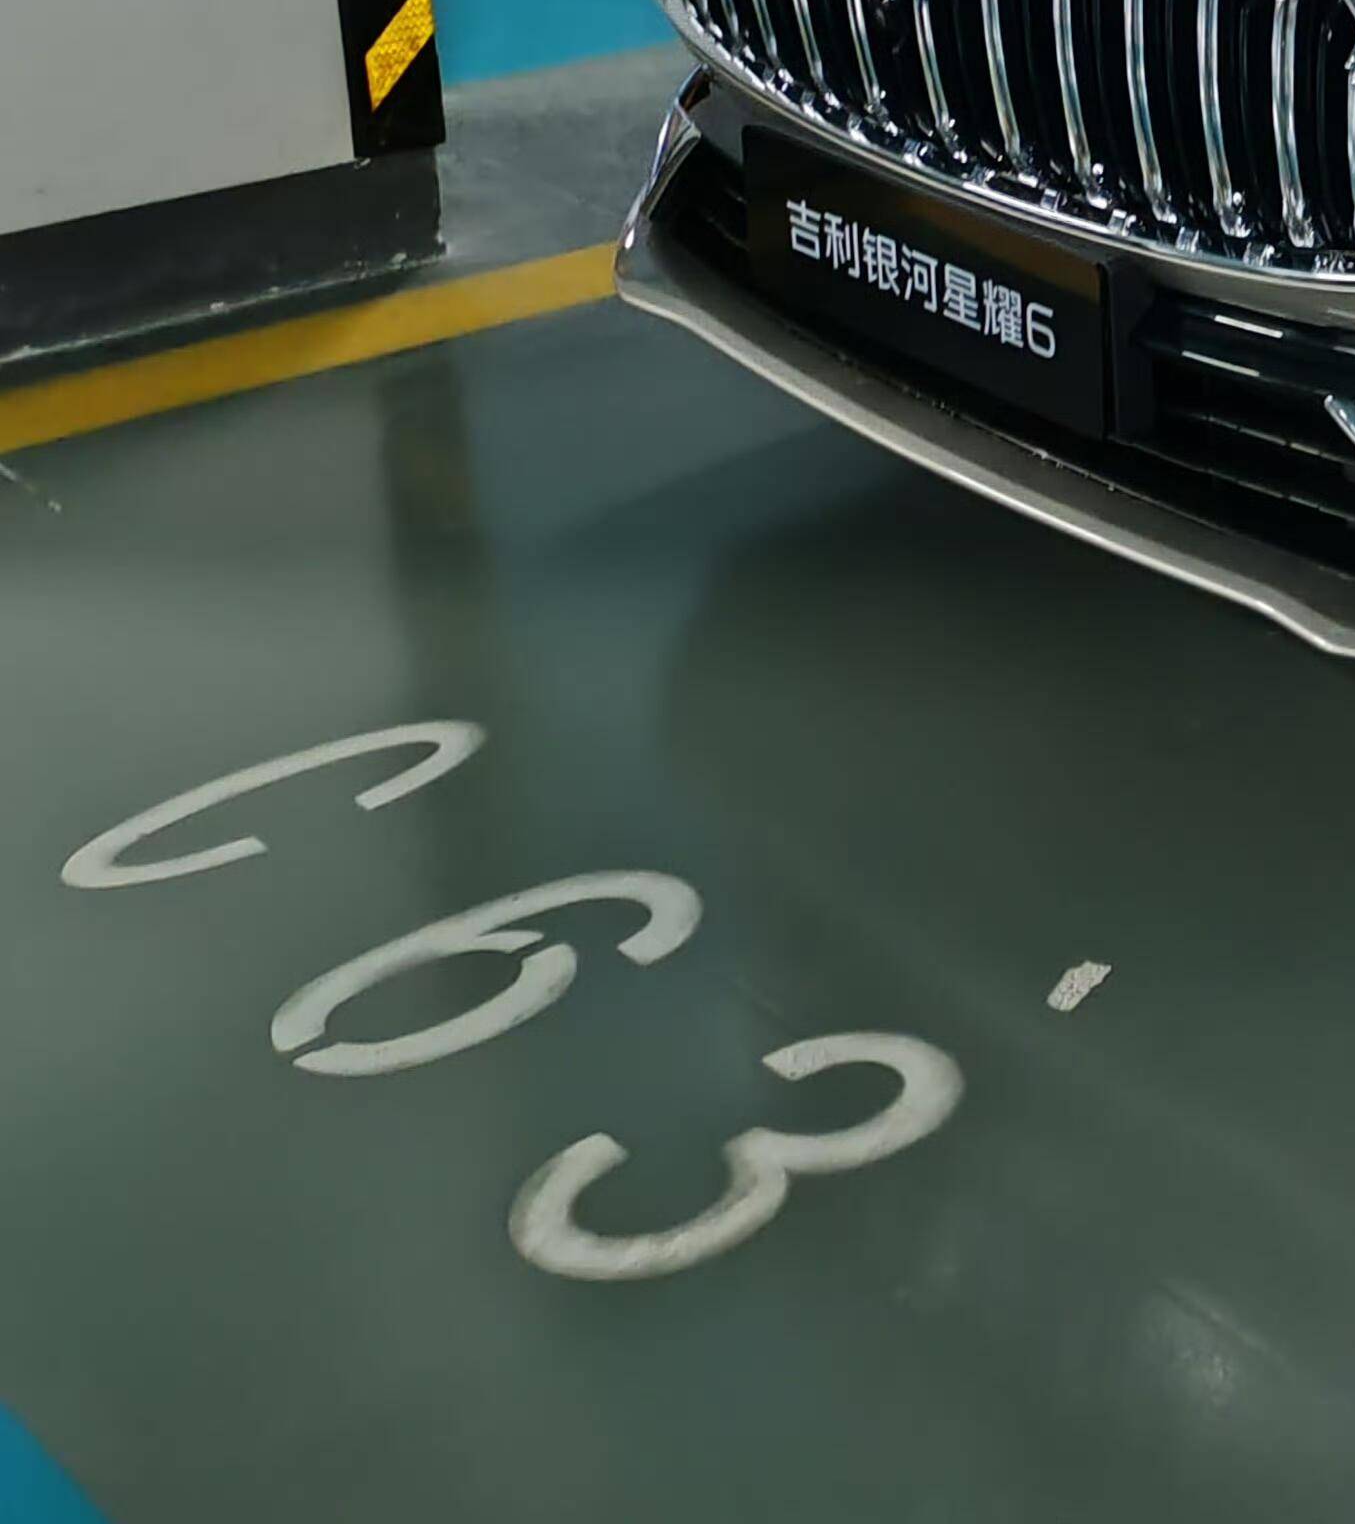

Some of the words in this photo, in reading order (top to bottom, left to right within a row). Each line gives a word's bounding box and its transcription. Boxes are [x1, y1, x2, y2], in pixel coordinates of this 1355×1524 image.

[786, 198, 1056, 359] 吉利银河星耀6
[61, 719, 965, 1279] C63
